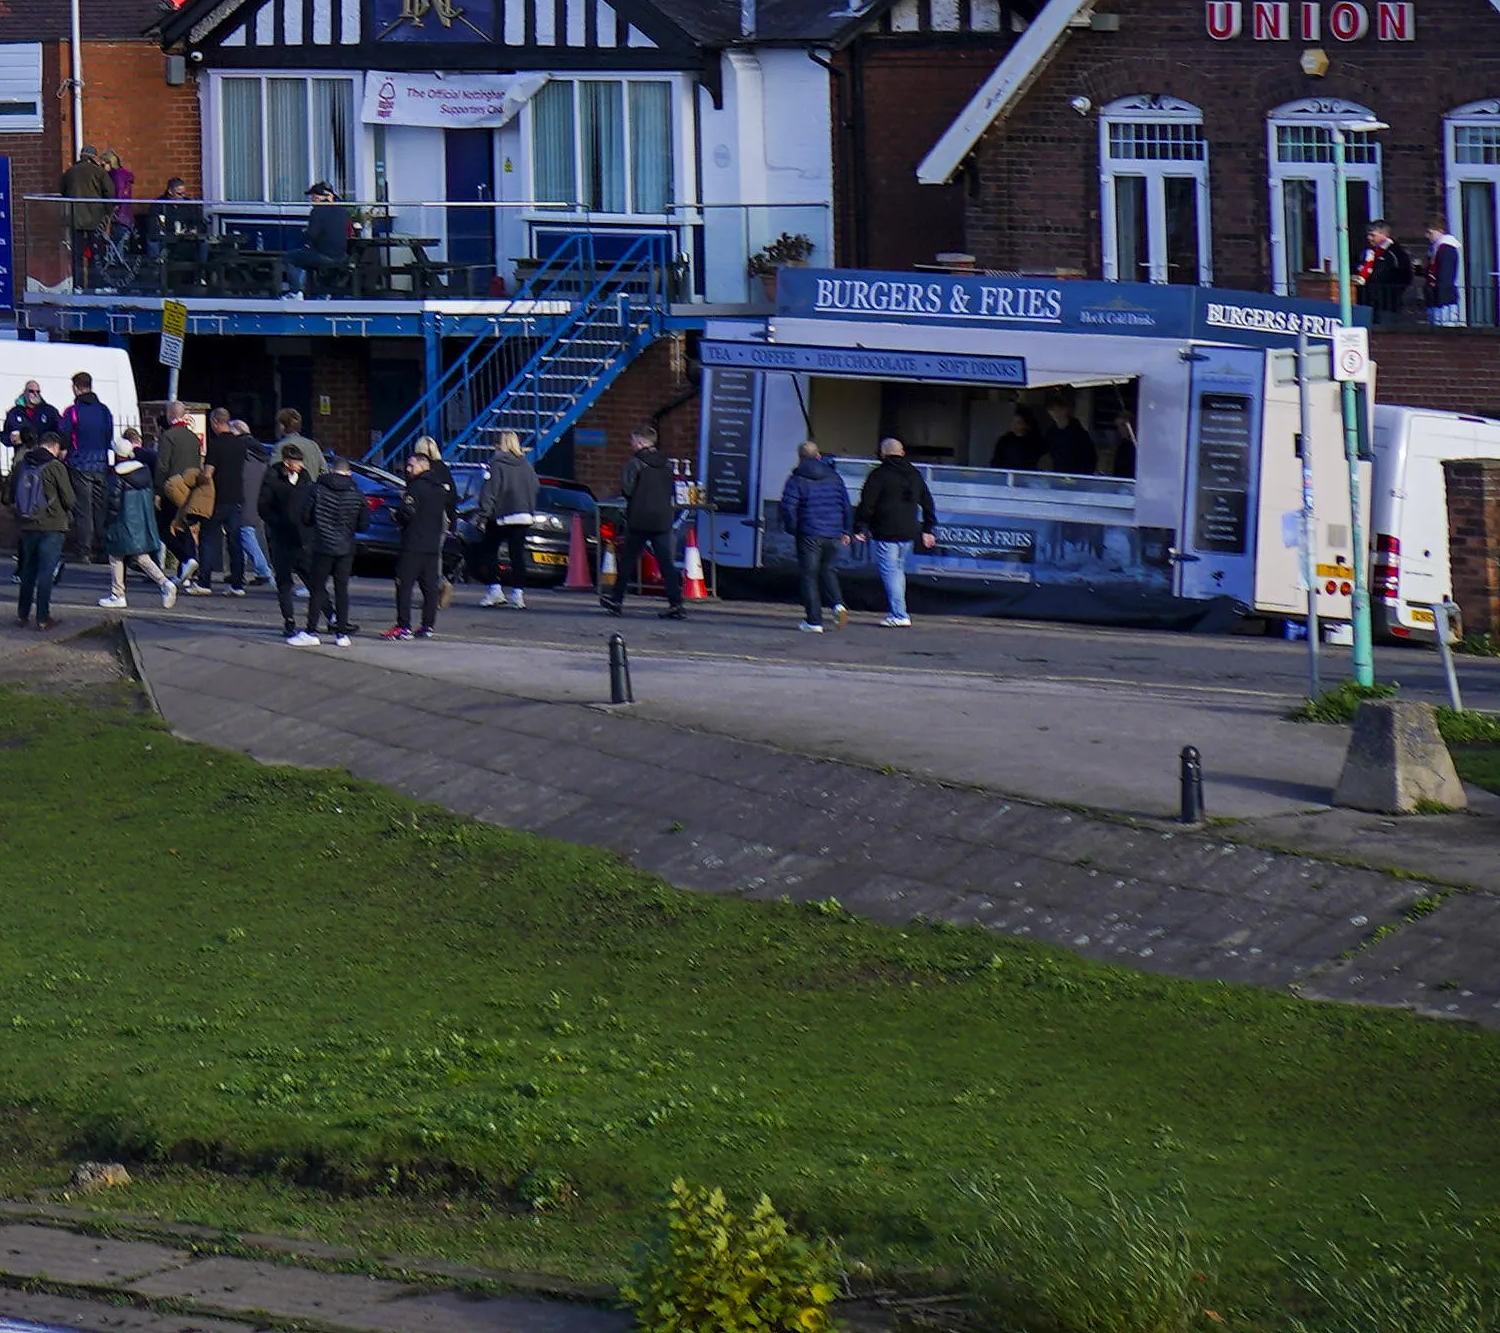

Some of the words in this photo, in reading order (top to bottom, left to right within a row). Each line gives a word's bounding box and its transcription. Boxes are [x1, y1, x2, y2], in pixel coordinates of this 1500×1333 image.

[1205, 0, 1416, 43] UNION
[406, 88, 425, 100] The
[816, 279, 942, 312] BURGERS
[949, 284, 970, 315] &
[980, 285, 1062, 319] FRIES
[1206, 302, 1287, 329] BURGERS
[1286, 310, 1301, 331] &
[708, 346, 731, 361] TEA
[751, 349, 797, 365] COFFEE
[817, 353, 846, 367] HOT
[846, 354, 917, 372] CHOCOLATE
[938, 359, 972, 375] SOFT
[972, 361, 1018, 378] DRINKS
